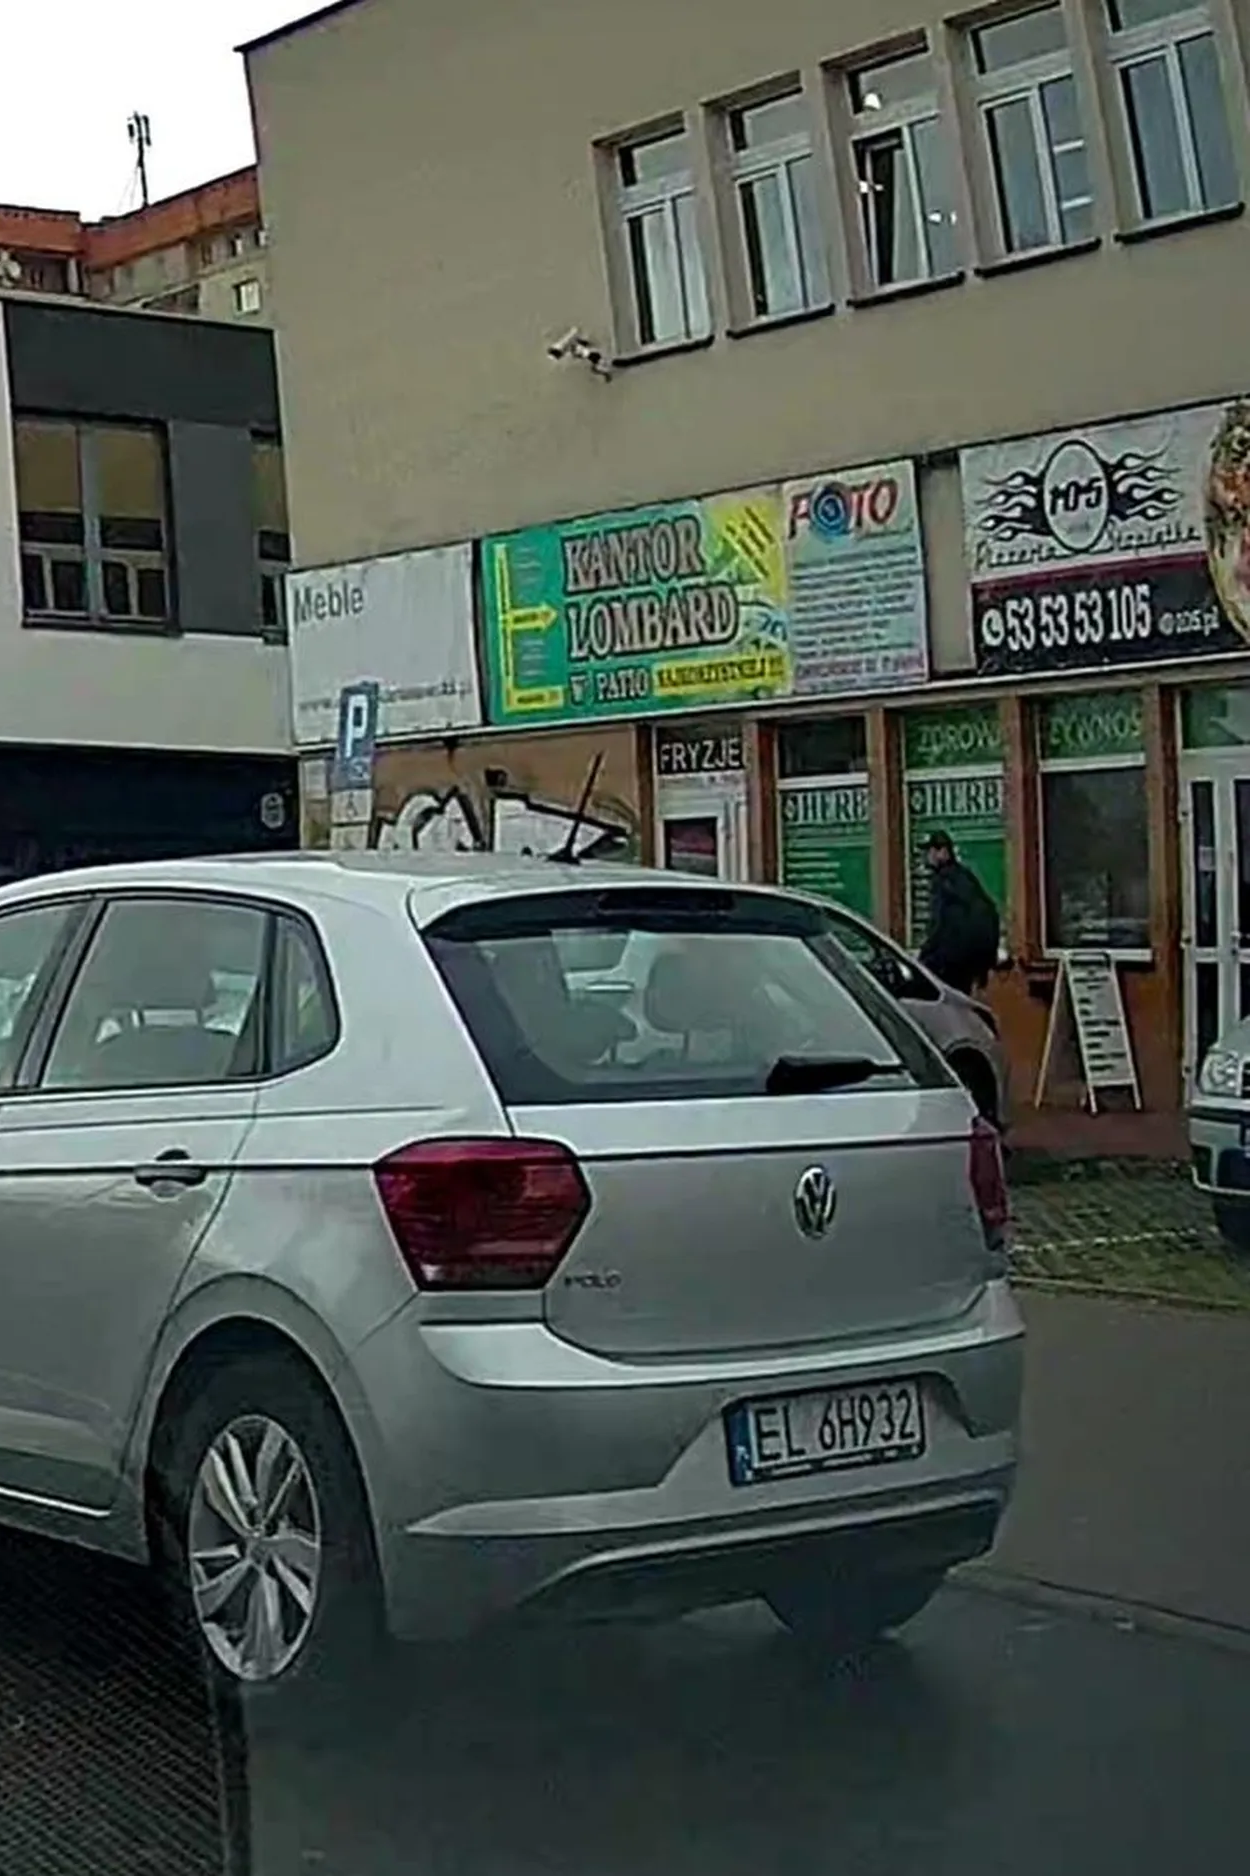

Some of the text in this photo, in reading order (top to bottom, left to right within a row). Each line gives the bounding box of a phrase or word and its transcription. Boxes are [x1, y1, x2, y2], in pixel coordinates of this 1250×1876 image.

[789, 478, 898, 539] FOTO
[1049, 476, 1102, 516] 105
[563, 516, 703, 593] KANTOR
[293, 579, 364, 628] Meble
[567, 581, 738, 660] LOMBARD
[1006, 597, 1035, 651] 53
[1040, 593, 1068, 646] 53
[1074, 588, 1103, 643] 53
[1107, 583, 1151, 640] 105
[596, 668, 647, 701] PATIO
[345, 694, 368, 758] P
[659, 737, 746, 770] FRYZJE
[755, 1388, 916, 1462] EL 6H932
